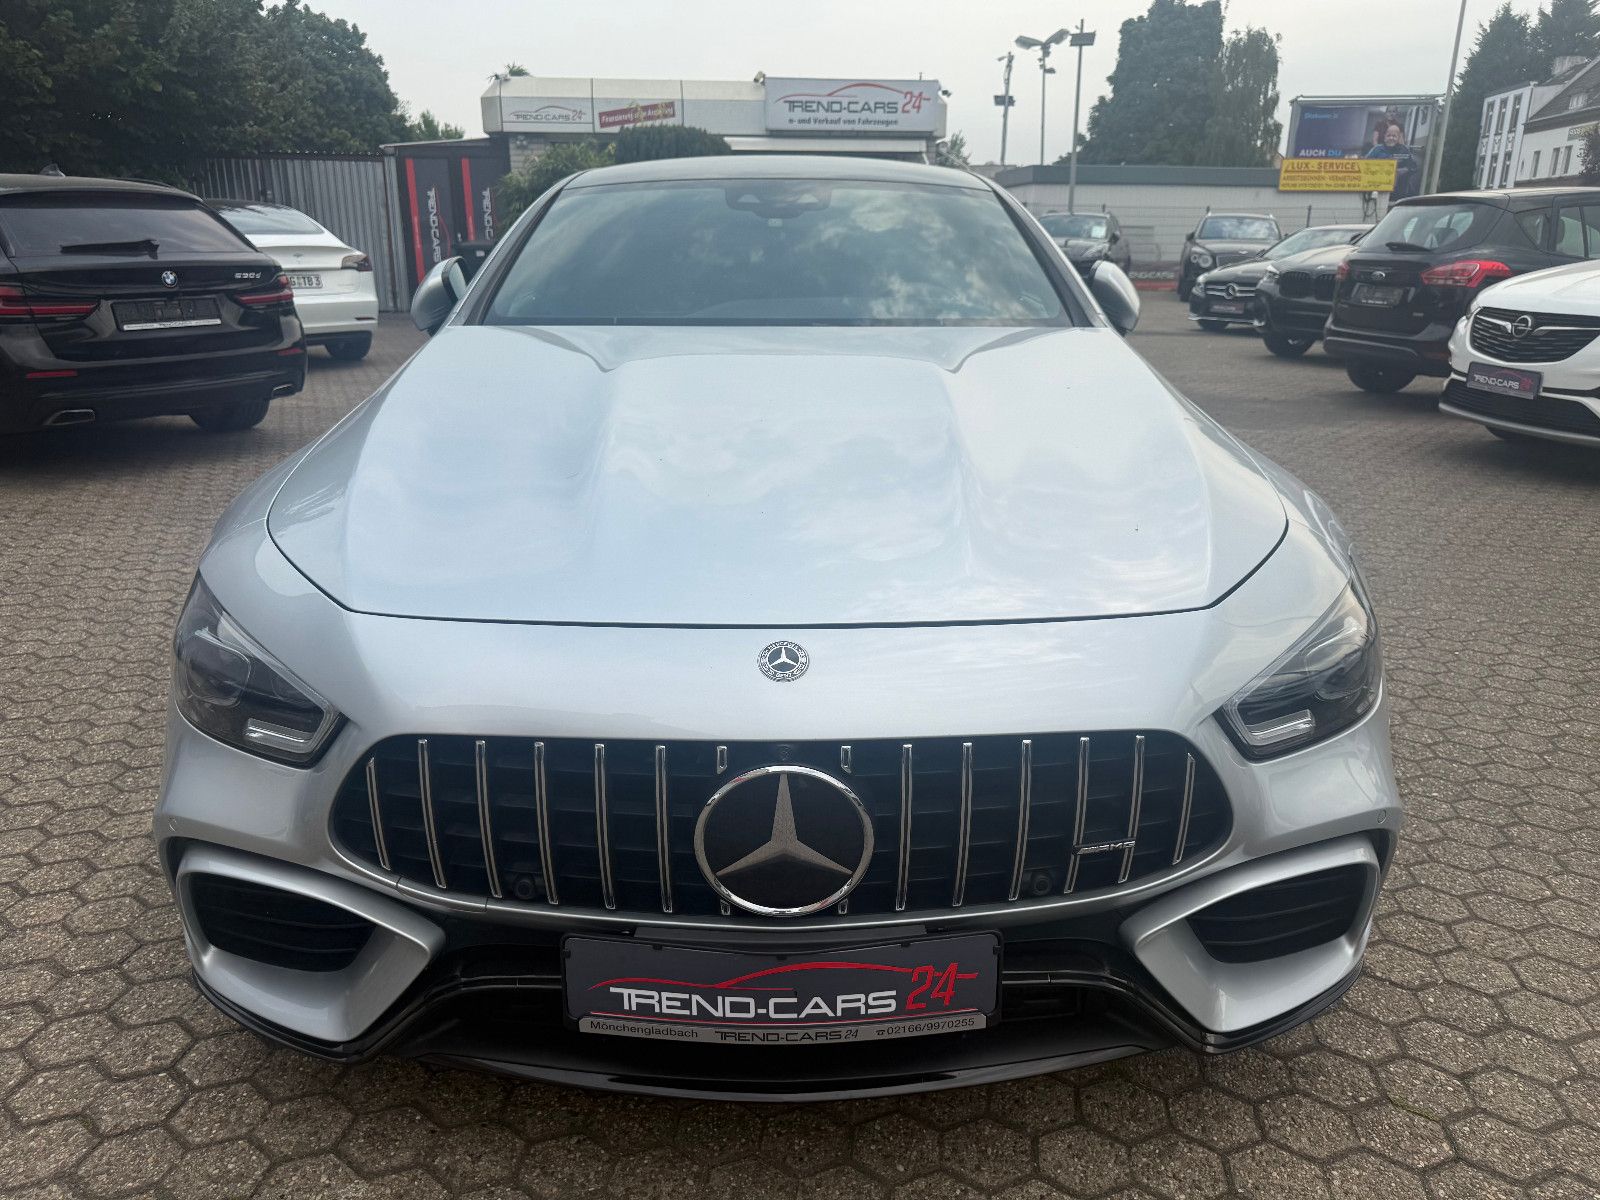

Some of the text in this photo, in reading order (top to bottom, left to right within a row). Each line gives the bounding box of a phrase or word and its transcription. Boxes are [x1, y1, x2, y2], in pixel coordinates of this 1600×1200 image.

[784, 91, 927, 114] TREND-CARS 24
[1299, 149, 1326, 157] AUCH
[1318, 162, 1356, 170] SERVICE
[610, 962, 968, 1019] TREND-CARS 24
[590, 1017, 975, 1042] Mönchengladbach TREND-CARS 24 02166/9970255
